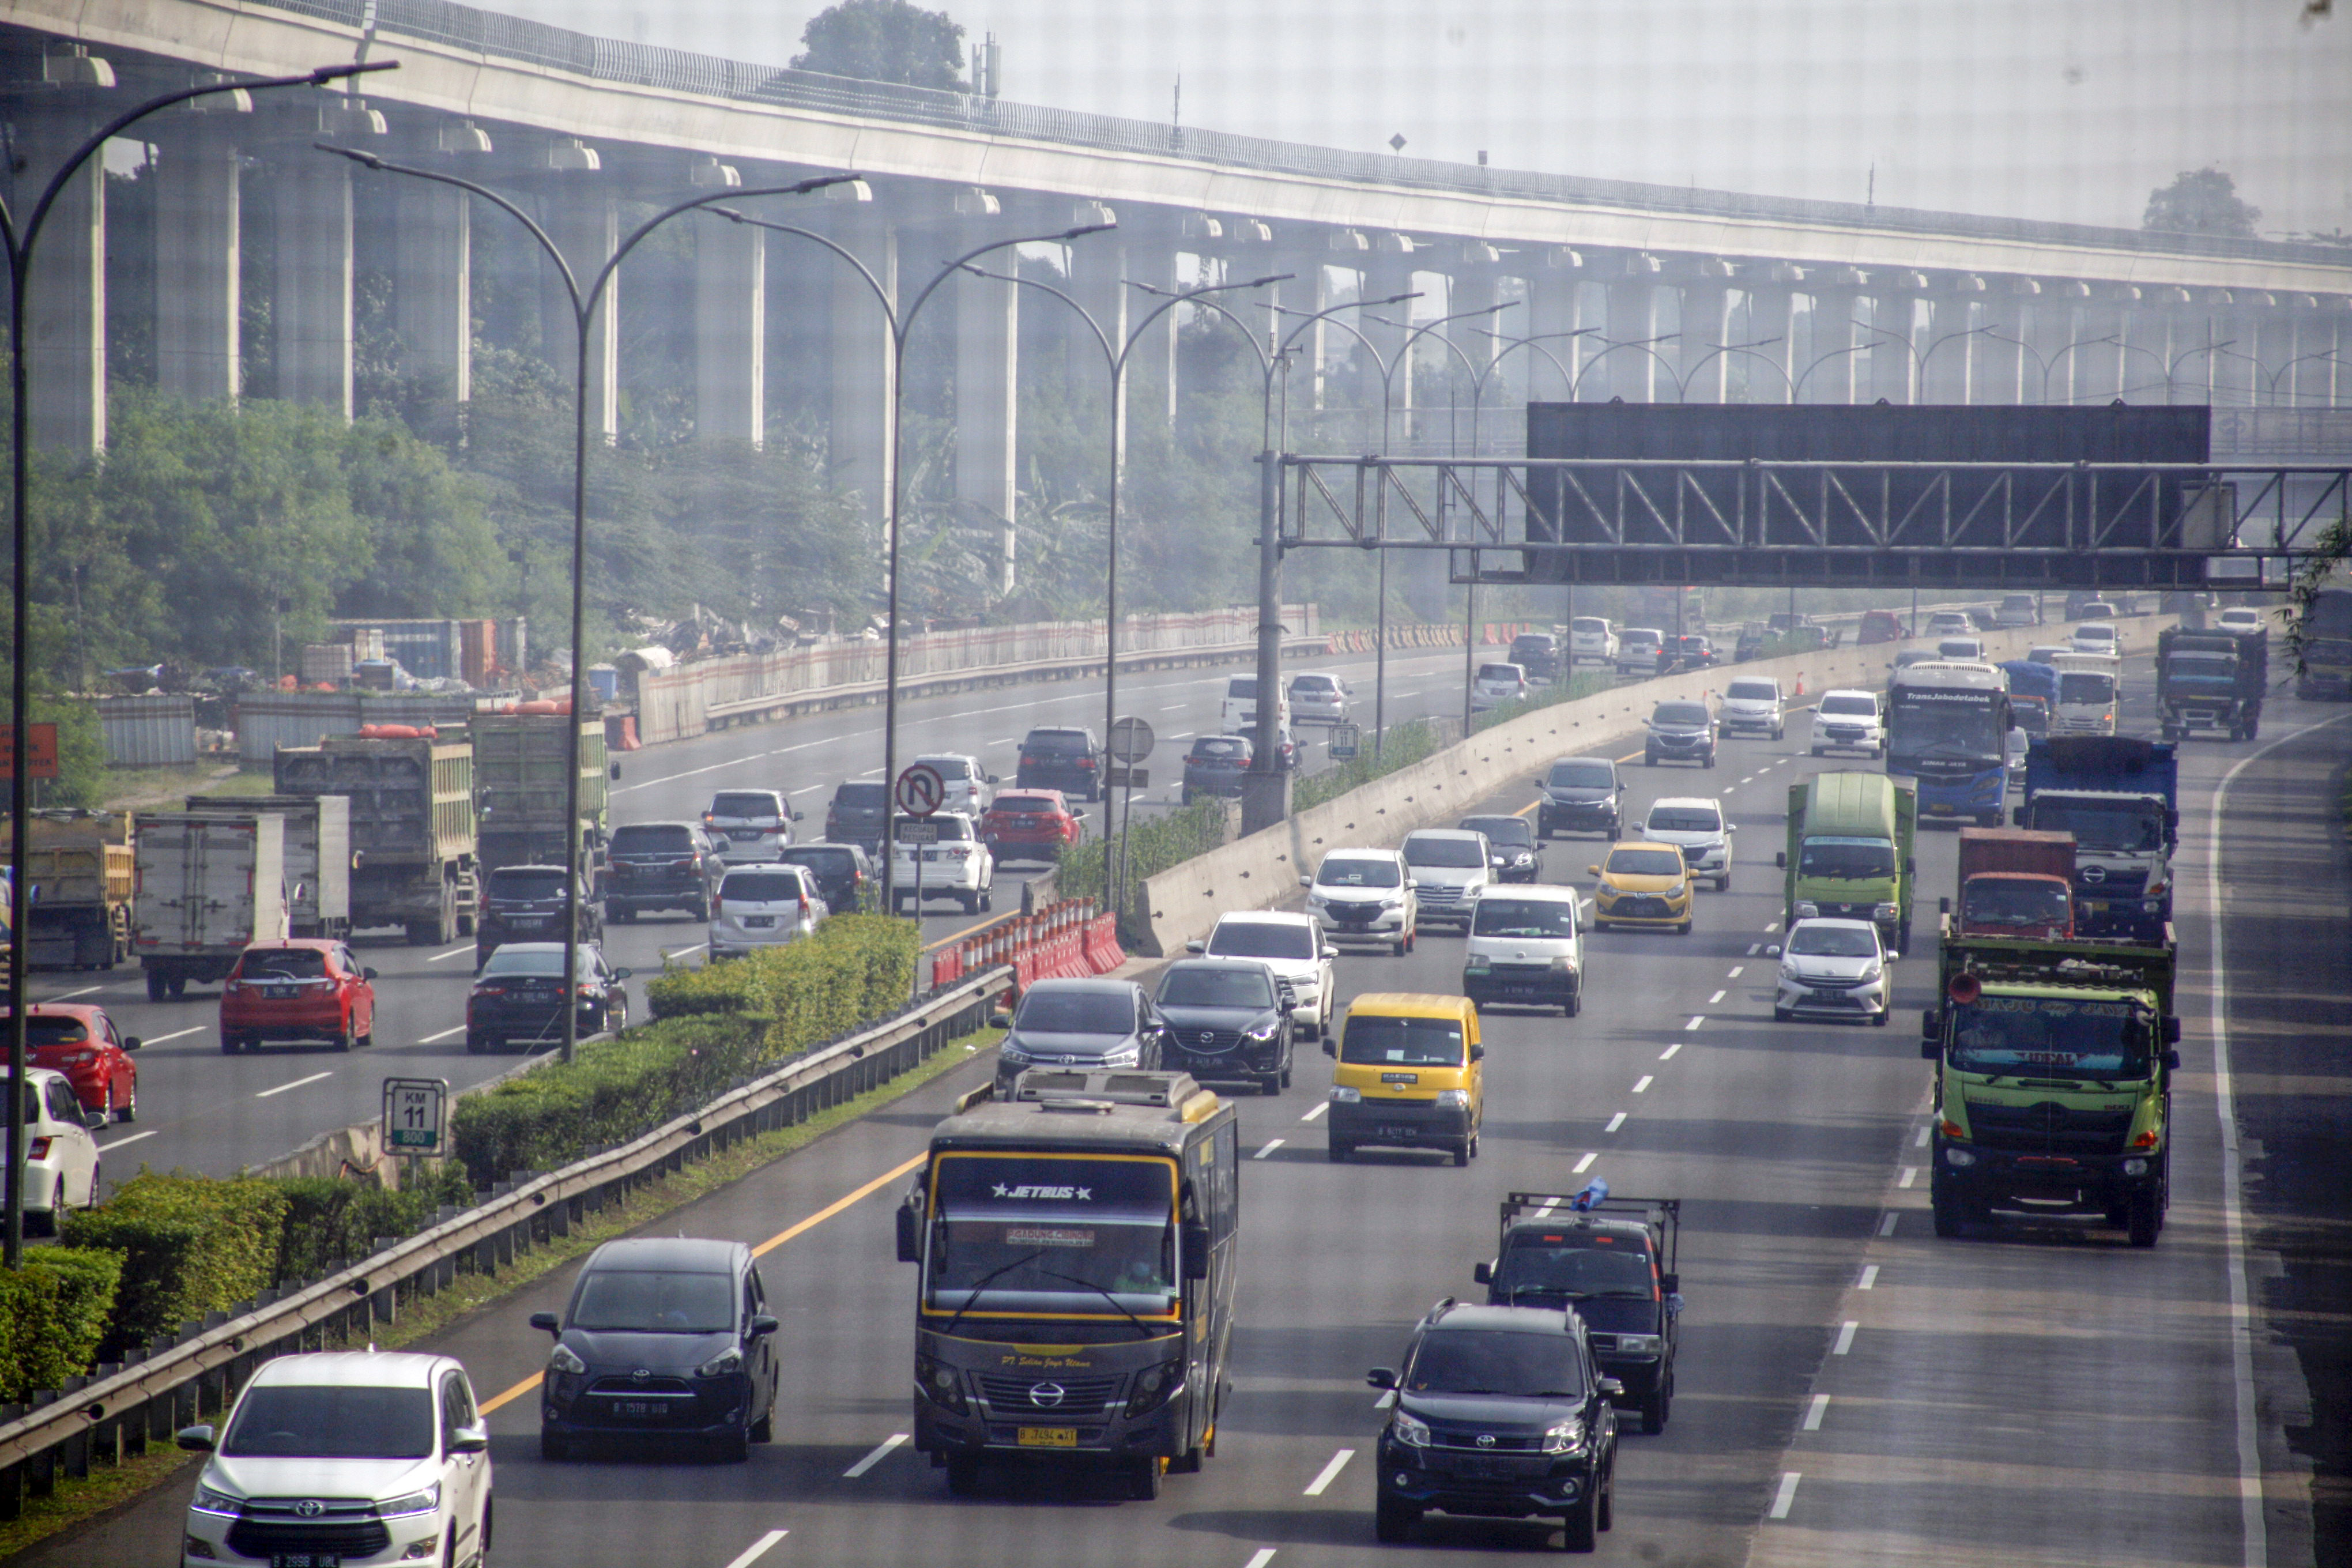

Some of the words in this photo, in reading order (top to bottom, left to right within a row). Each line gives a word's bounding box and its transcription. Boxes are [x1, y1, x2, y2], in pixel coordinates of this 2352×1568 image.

[1907, 693, 1991, 702] TransJabodetabek
[904, 825, 933, 833] KECUALI
[1974, 998, 2036, 1013] MAJU
[2080, 1002, 2135, 1018] JAYA
[405, 1092, 426, 1103] KM
[405, 1106, 424, 1128] 11
[404, 1132, 425, 1144] 800
[1008, 1186, 1075, 1198] JETBUS
[1020, 1429, 1025, 1439] B
[274, 1556, 280, 1567] B
